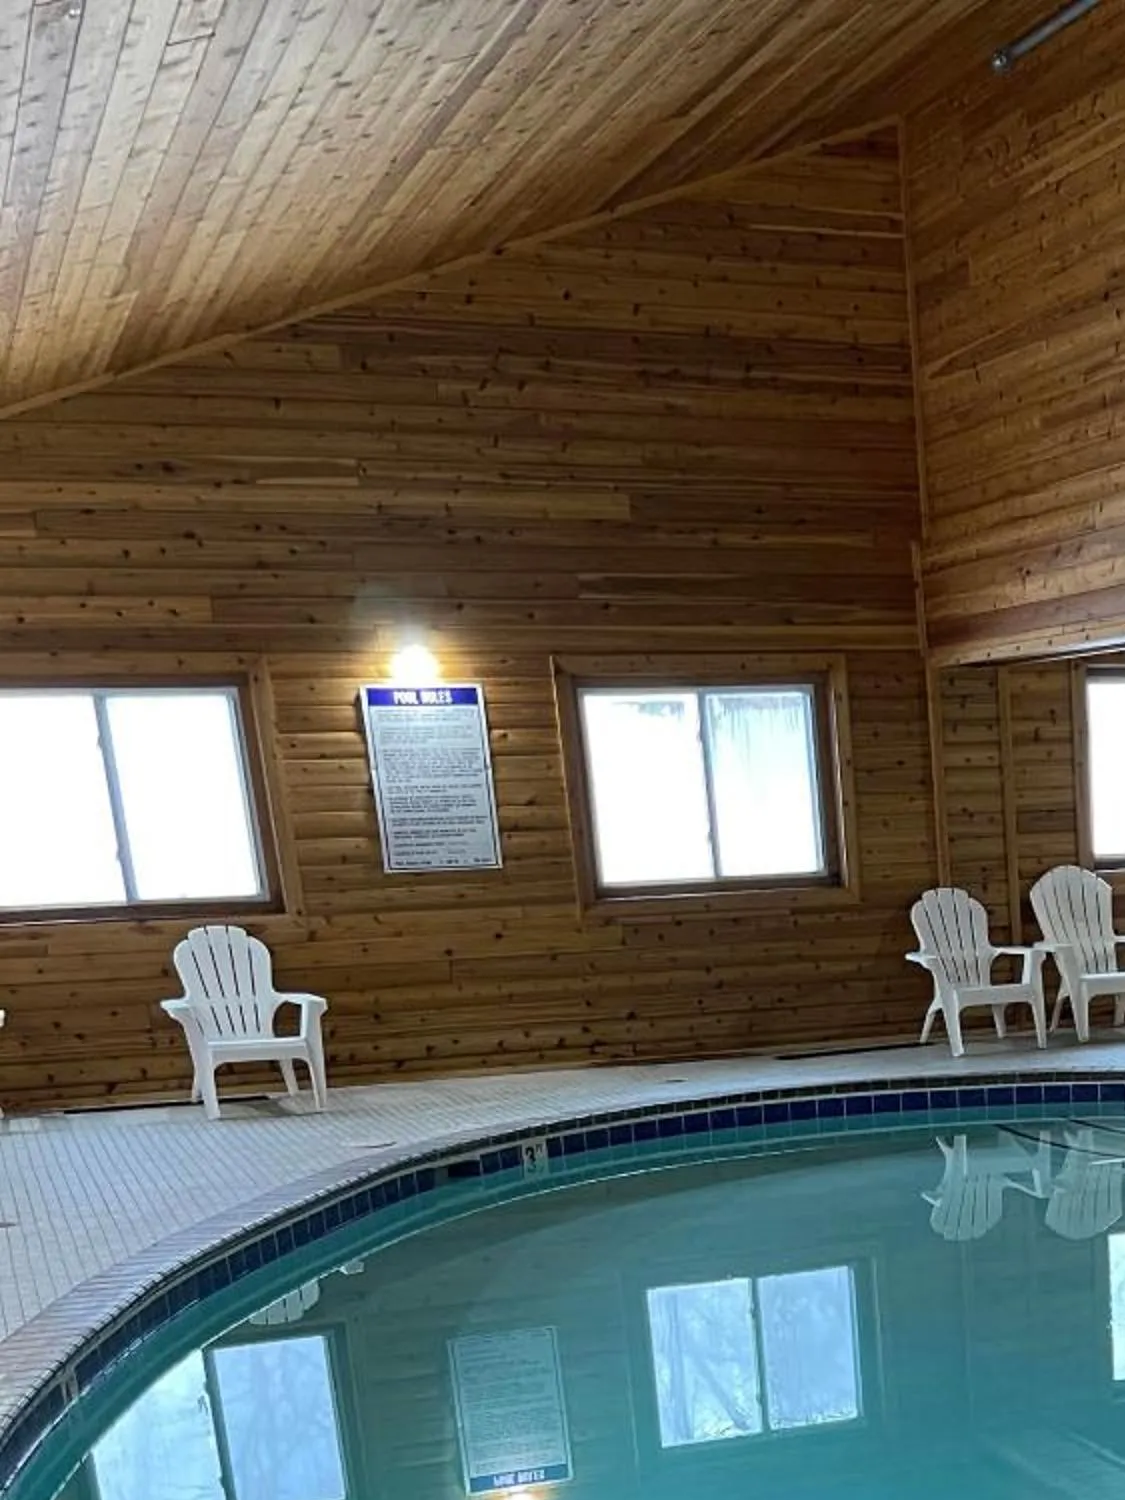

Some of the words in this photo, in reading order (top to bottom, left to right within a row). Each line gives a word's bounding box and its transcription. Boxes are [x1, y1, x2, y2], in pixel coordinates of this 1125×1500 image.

[393, 690, 418, 704] POOL
[420, 689, 452, 704] RULES
[525, 1146, 536, 1173] 3
